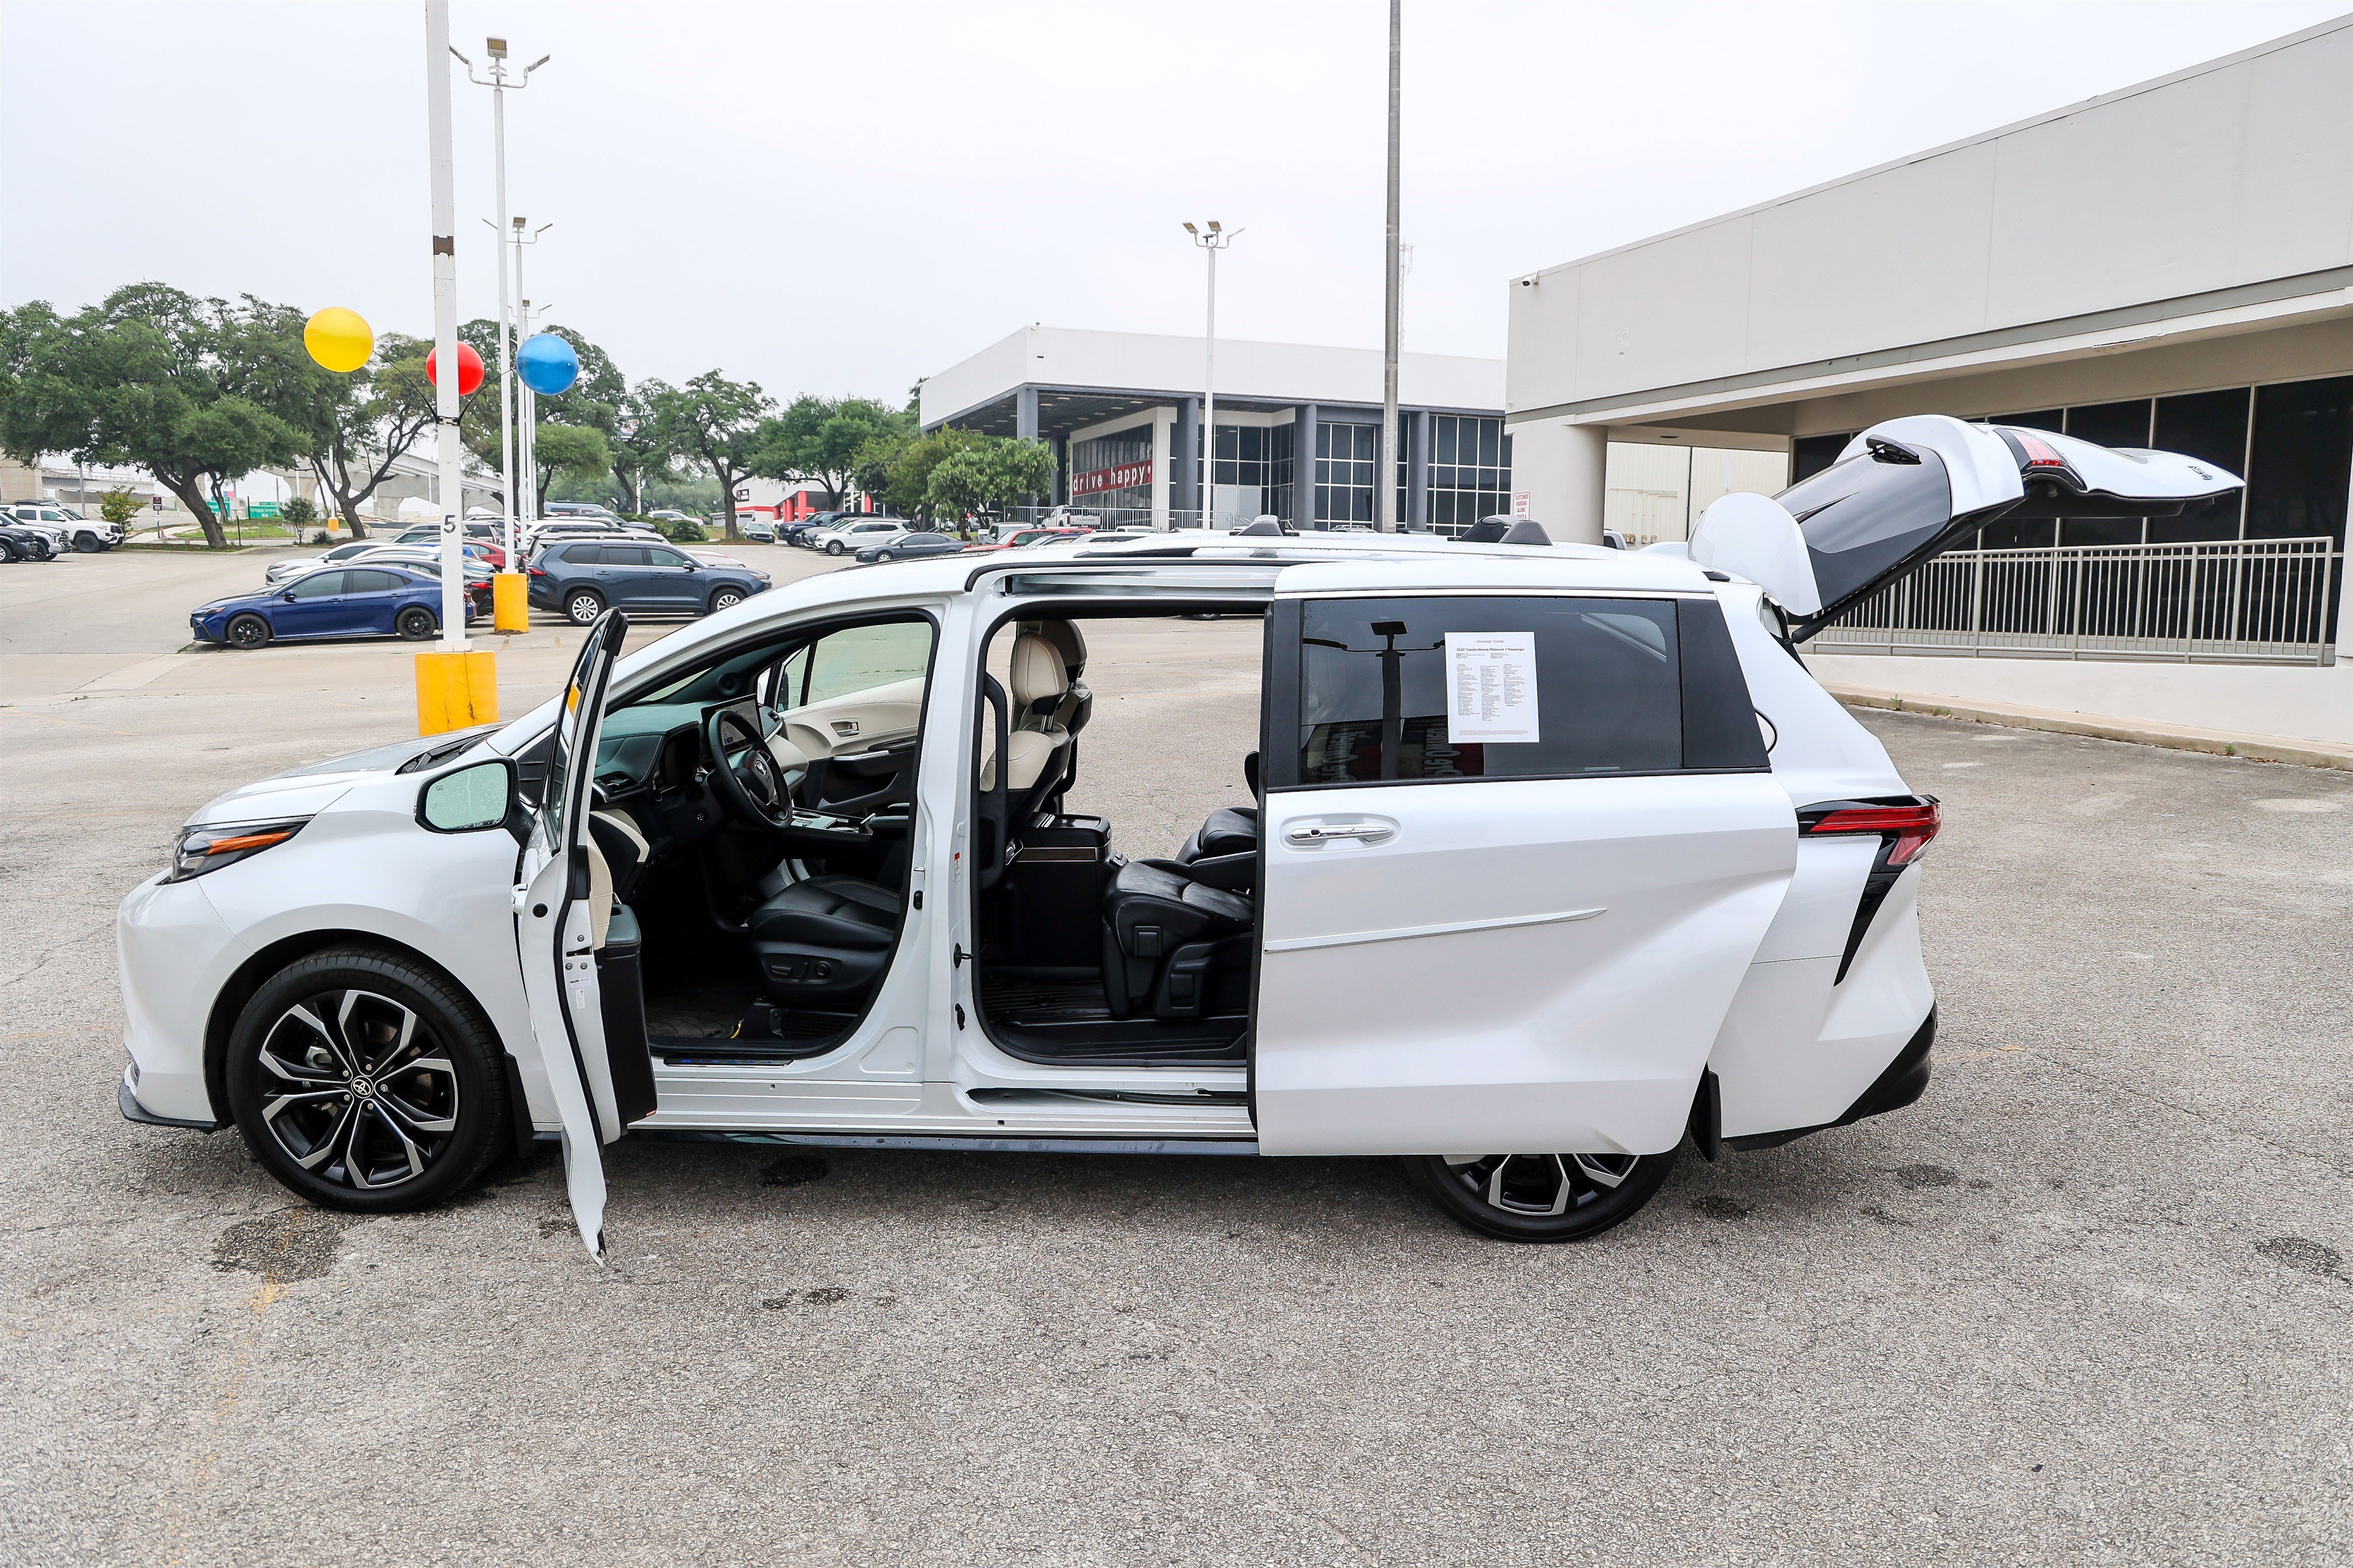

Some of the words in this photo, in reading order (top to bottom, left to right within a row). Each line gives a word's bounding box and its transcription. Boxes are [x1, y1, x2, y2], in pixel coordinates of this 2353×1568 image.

[1073, 472, 1102, 492] drive
[1110, 465, 1145, 488] happy
[443, 515, 456, 534] 5
